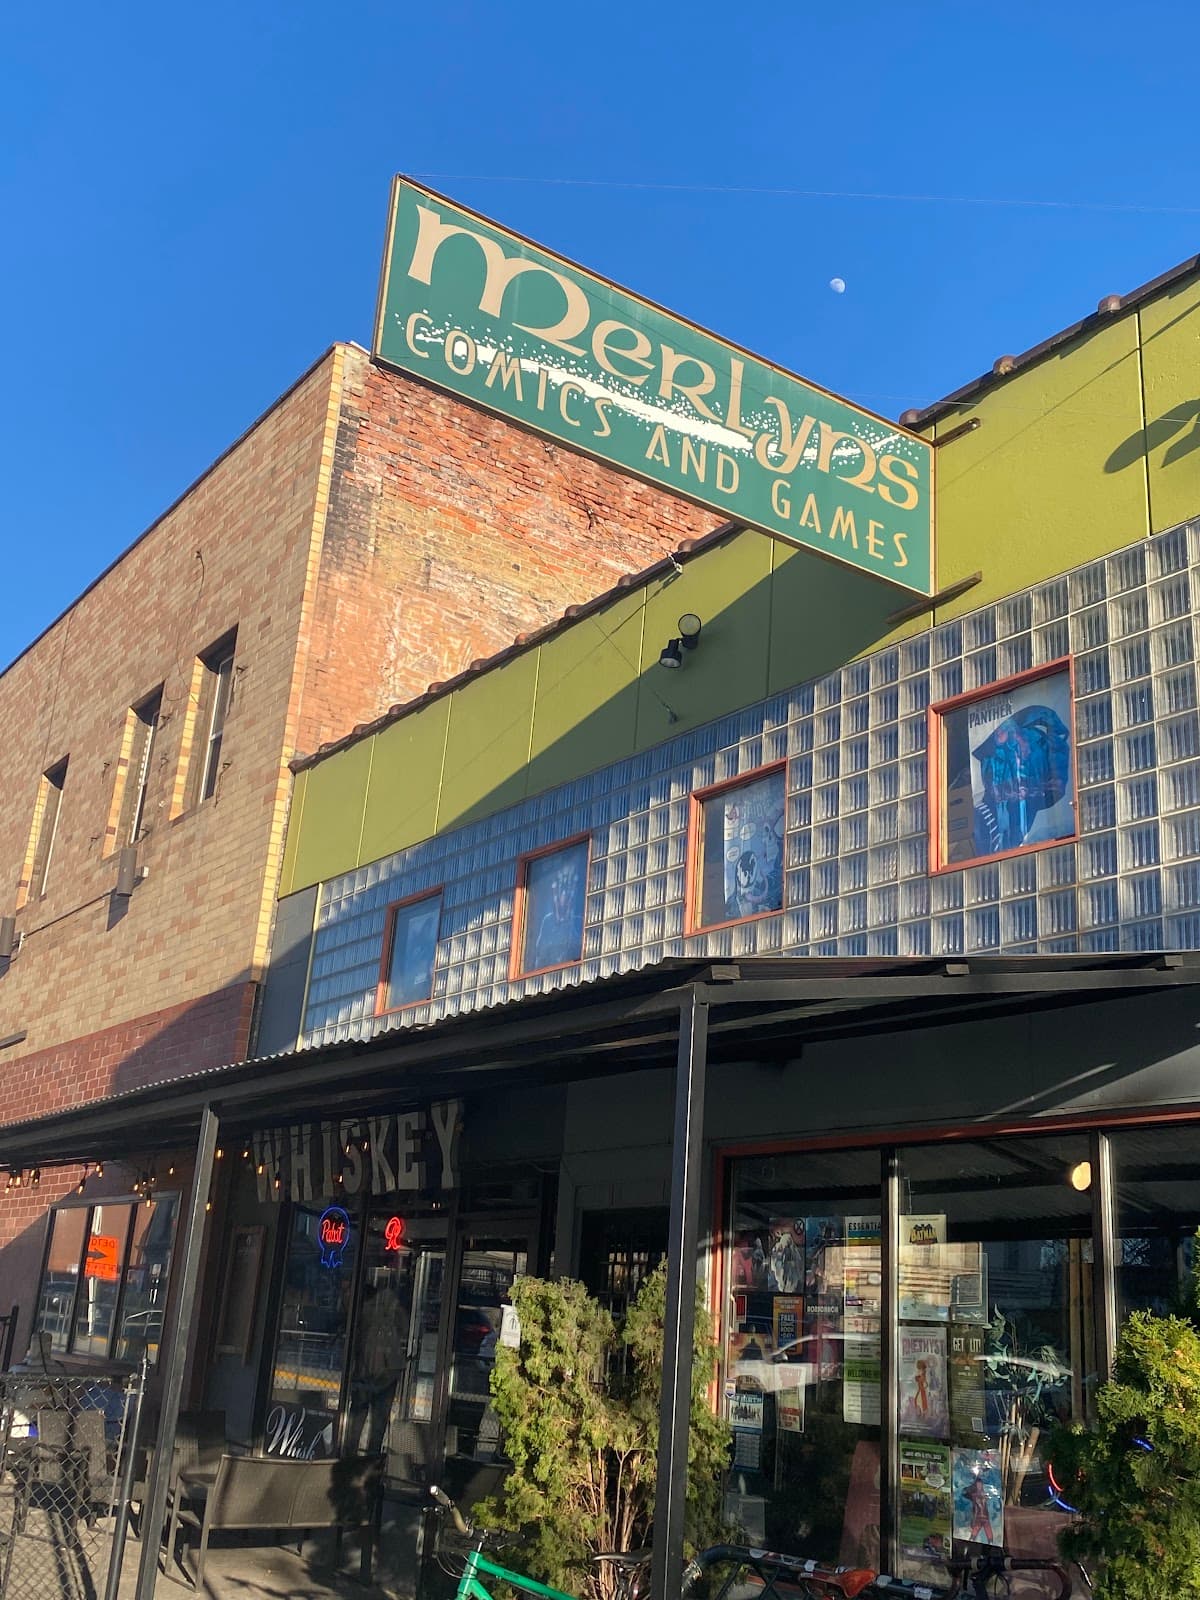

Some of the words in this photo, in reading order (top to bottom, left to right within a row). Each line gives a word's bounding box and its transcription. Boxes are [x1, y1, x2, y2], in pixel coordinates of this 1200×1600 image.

[406, 312, 613, 438] COMICS
[645, 425, 740, 494] AND
[772, 480, 908, 567] GAMES
[969, 702, 1013, 729] PANTHER
[251, 1099, 461, 1203] WHISKEY
[322, 1219, 345, 1244] Pabst
[953, 1338, 964, 1352] GET
